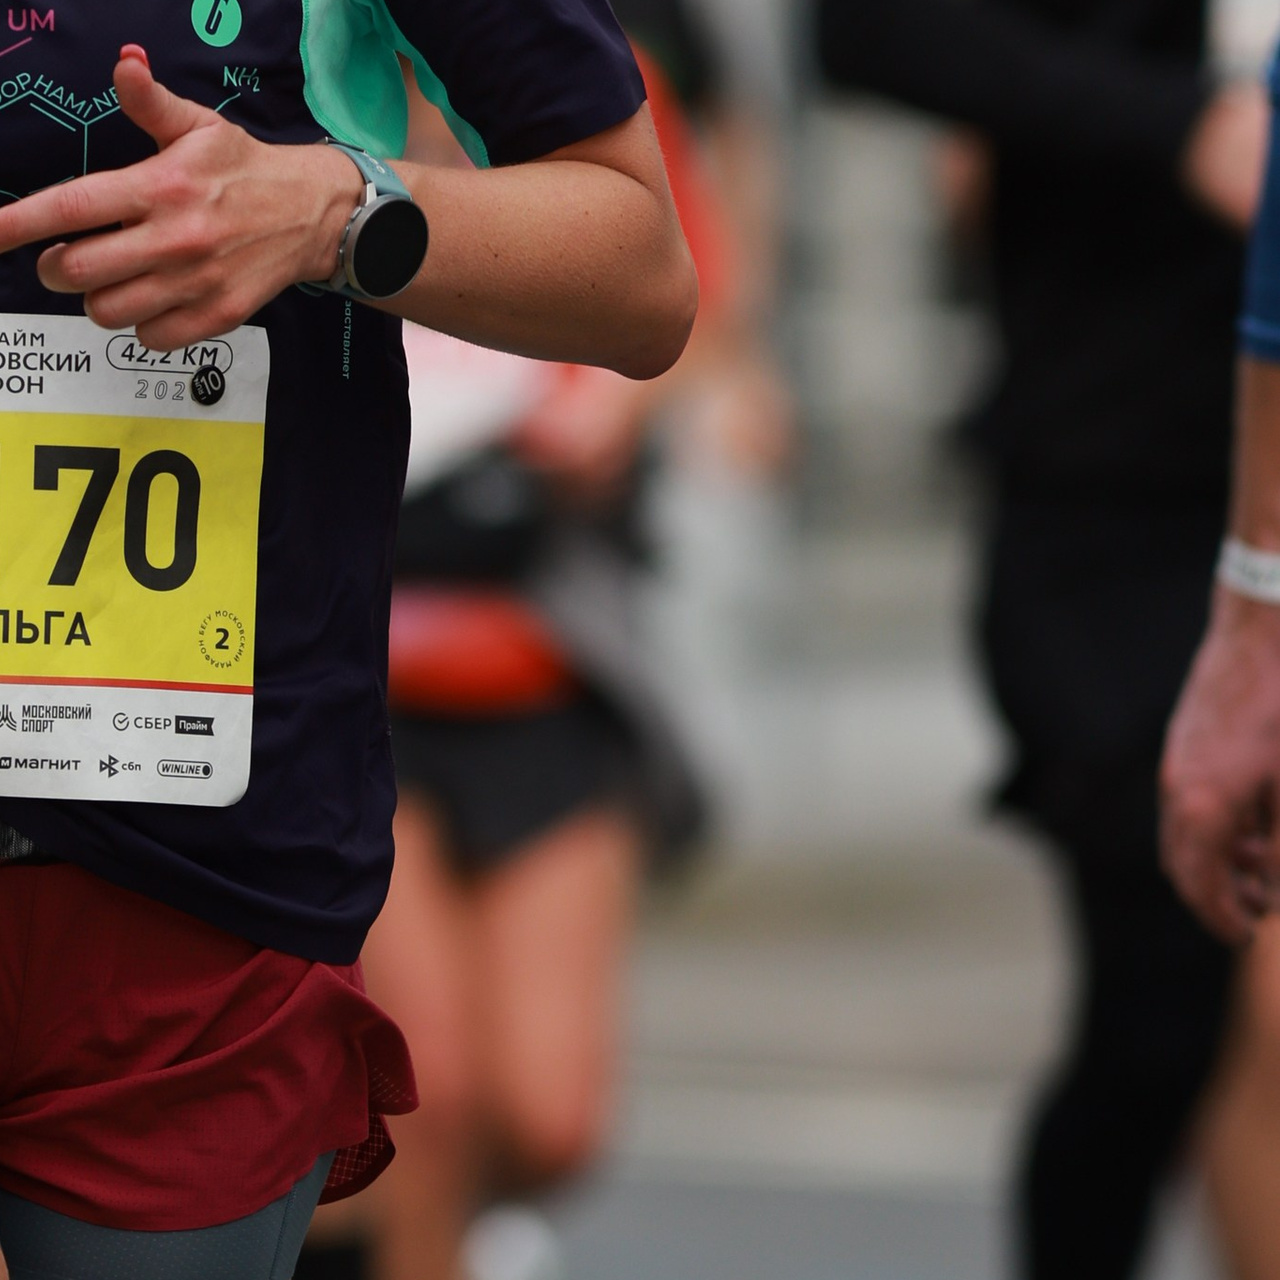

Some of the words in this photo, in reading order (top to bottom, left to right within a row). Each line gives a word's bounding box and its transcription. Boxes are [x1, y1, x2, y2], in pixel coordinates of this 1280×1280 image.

[7, 9, 55, 32] UM
[121, 342, 173, 367] 42,2
[135, 379, 192, 401] 202
[200, 370, 222, 395] 10
[215, 627, 230, 650] 2
[21, 704, 92, 720] МОСКОВСКИЙ
[21, 719, 55, 733] СПОРТ
[133, 716, 172, 730] СБЕР
[178, 720, 208, 731] Прайм
[161, 762, 202, 775] WINLINE
